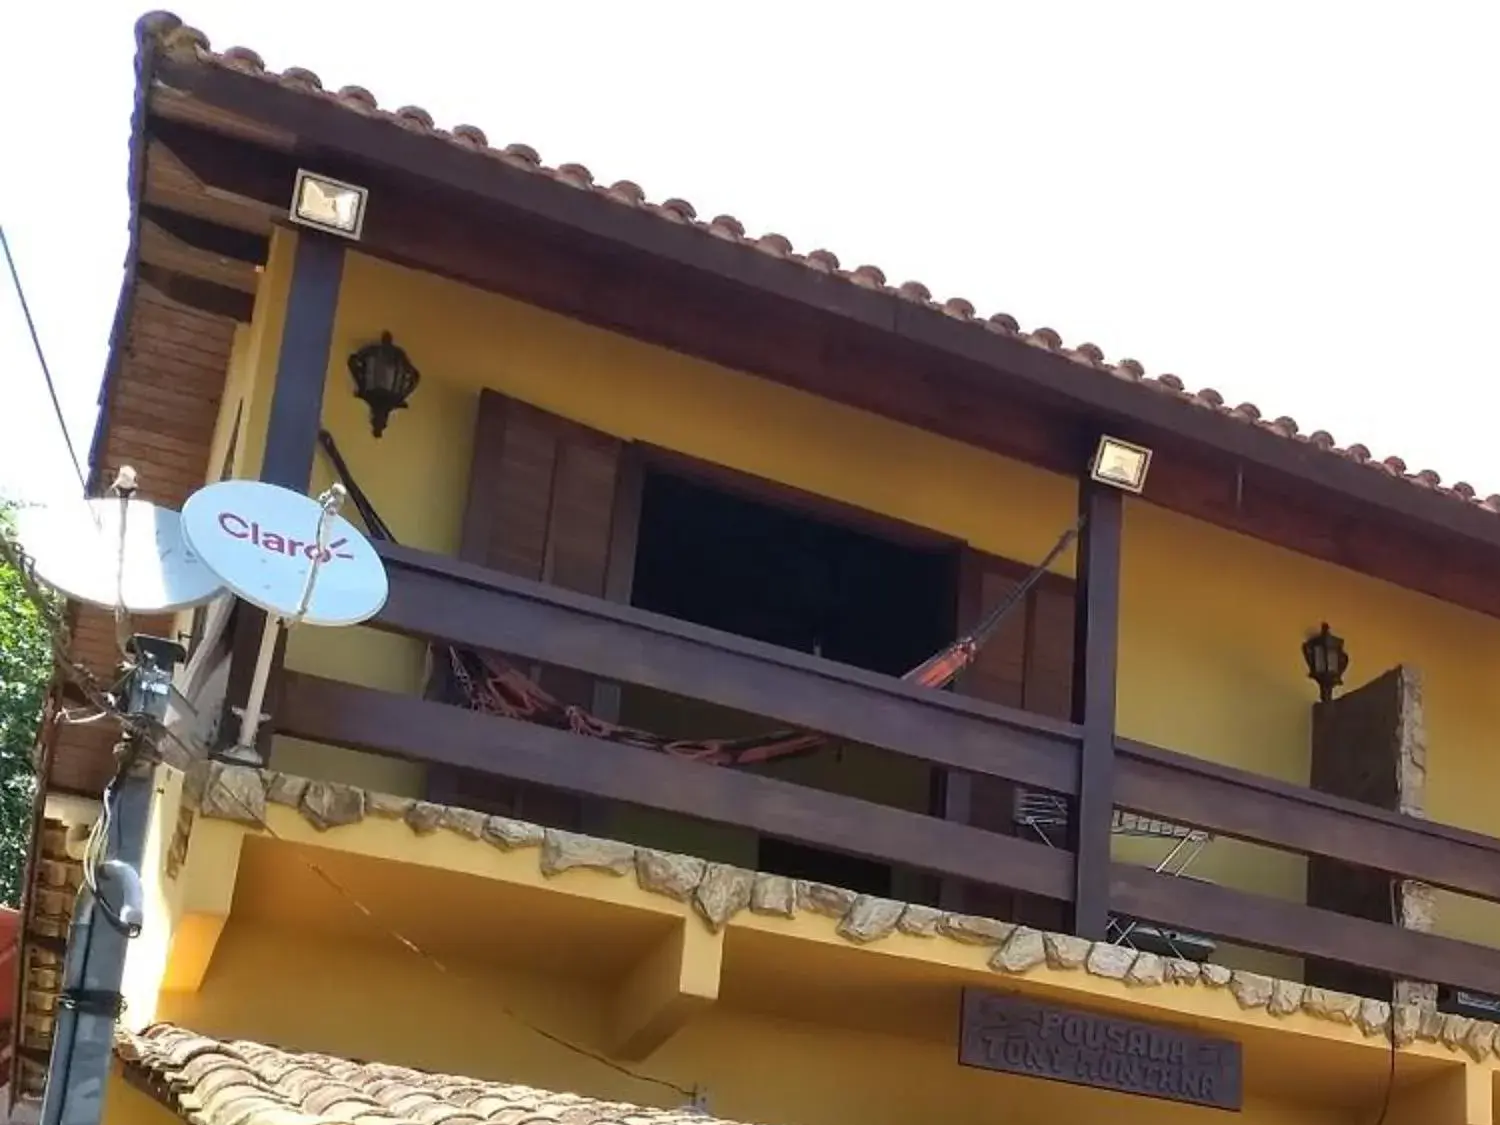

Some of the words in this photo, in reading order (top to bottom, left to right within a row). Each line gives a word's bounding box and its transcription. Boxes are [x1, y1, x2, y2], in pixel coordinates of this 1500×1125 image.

[218, 512, 332, 563] Claro
[1038, 1011, 1186, 1065] POUSADA
[983, 1035, 1065, 1073] TONY
[1075, 1049, 1216, 1101] MONTANA
